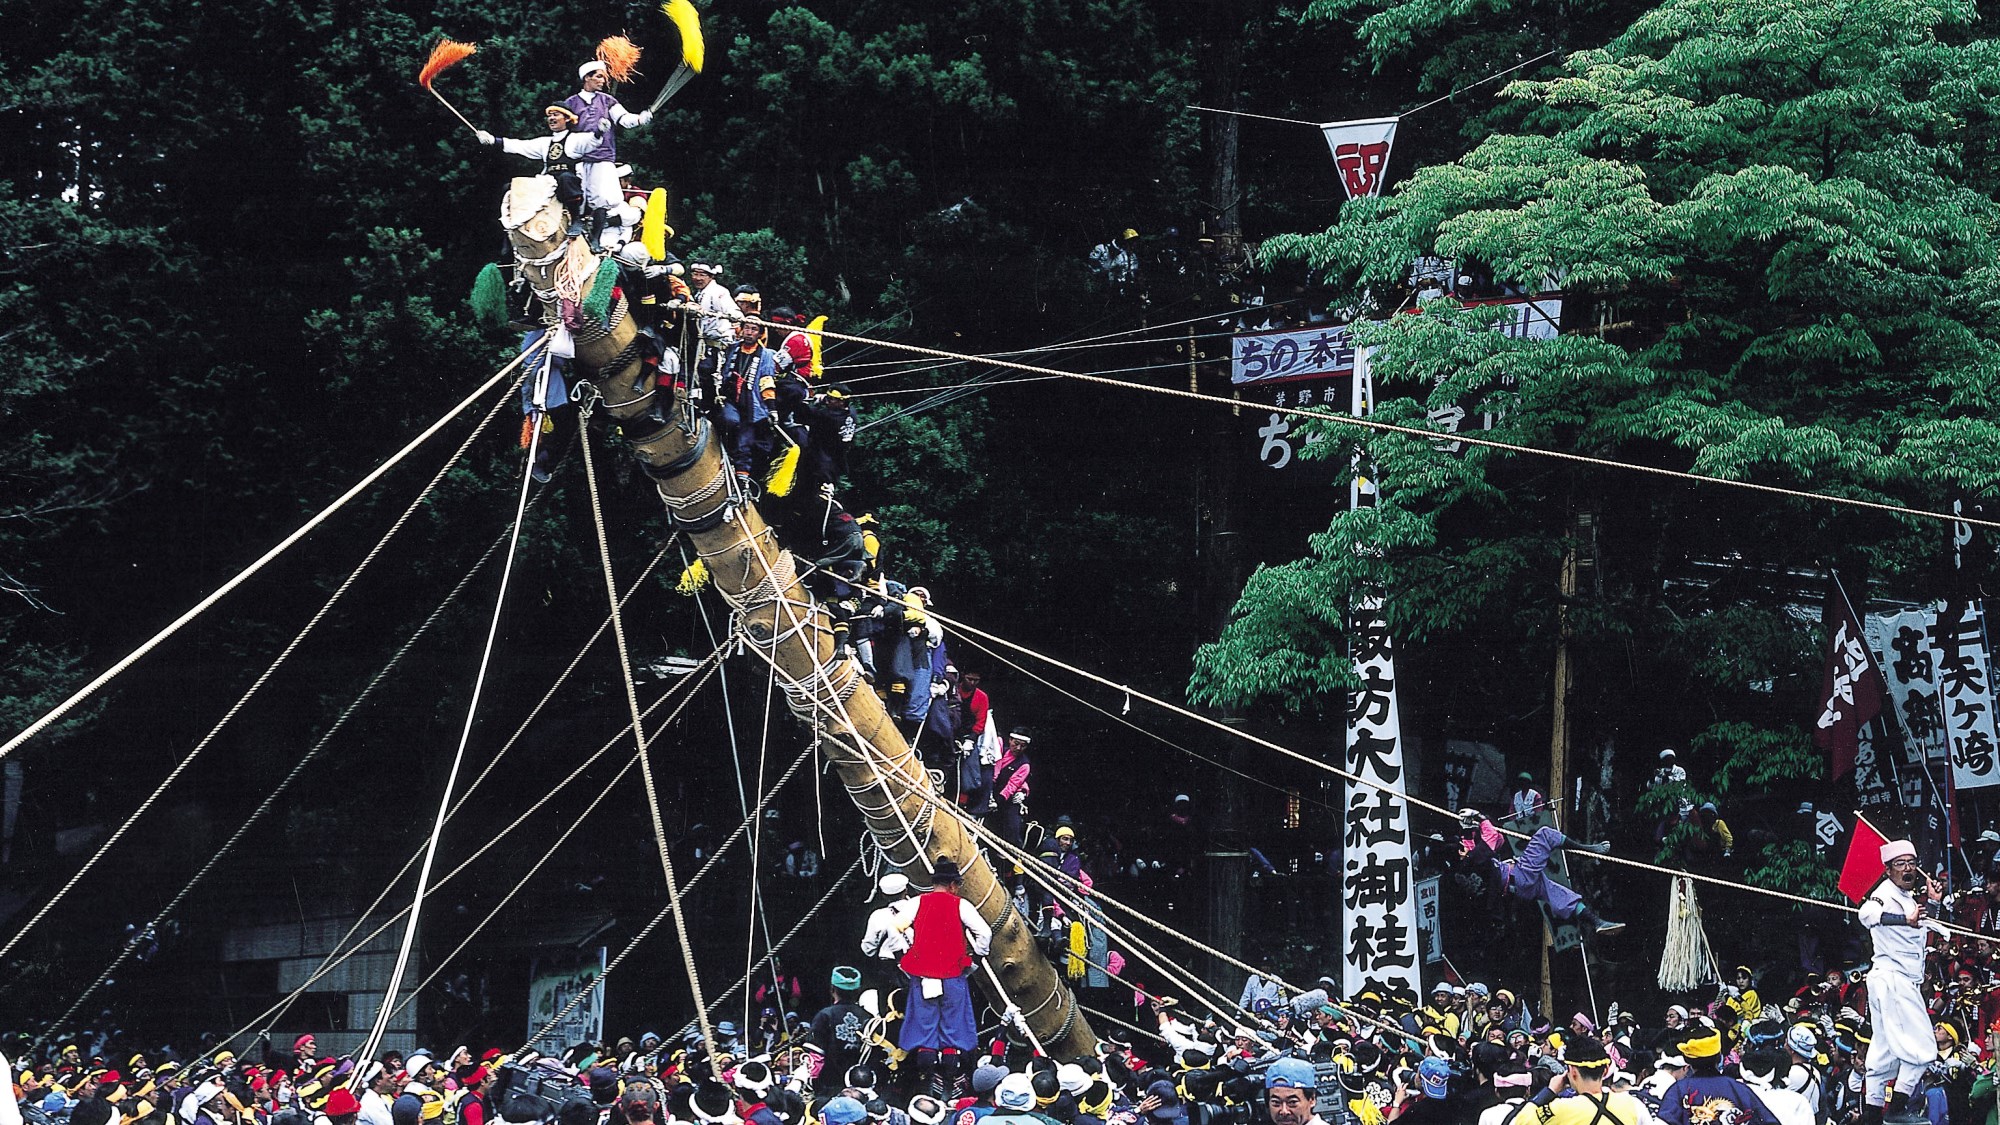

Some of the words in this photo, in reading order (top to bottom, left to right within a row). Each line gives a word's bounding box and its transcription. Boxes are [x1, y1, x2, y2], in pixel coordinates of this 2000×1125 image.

[1335, 141, 1389, 197] 祝
[1275, 386, 1336, 407] 茅野市
